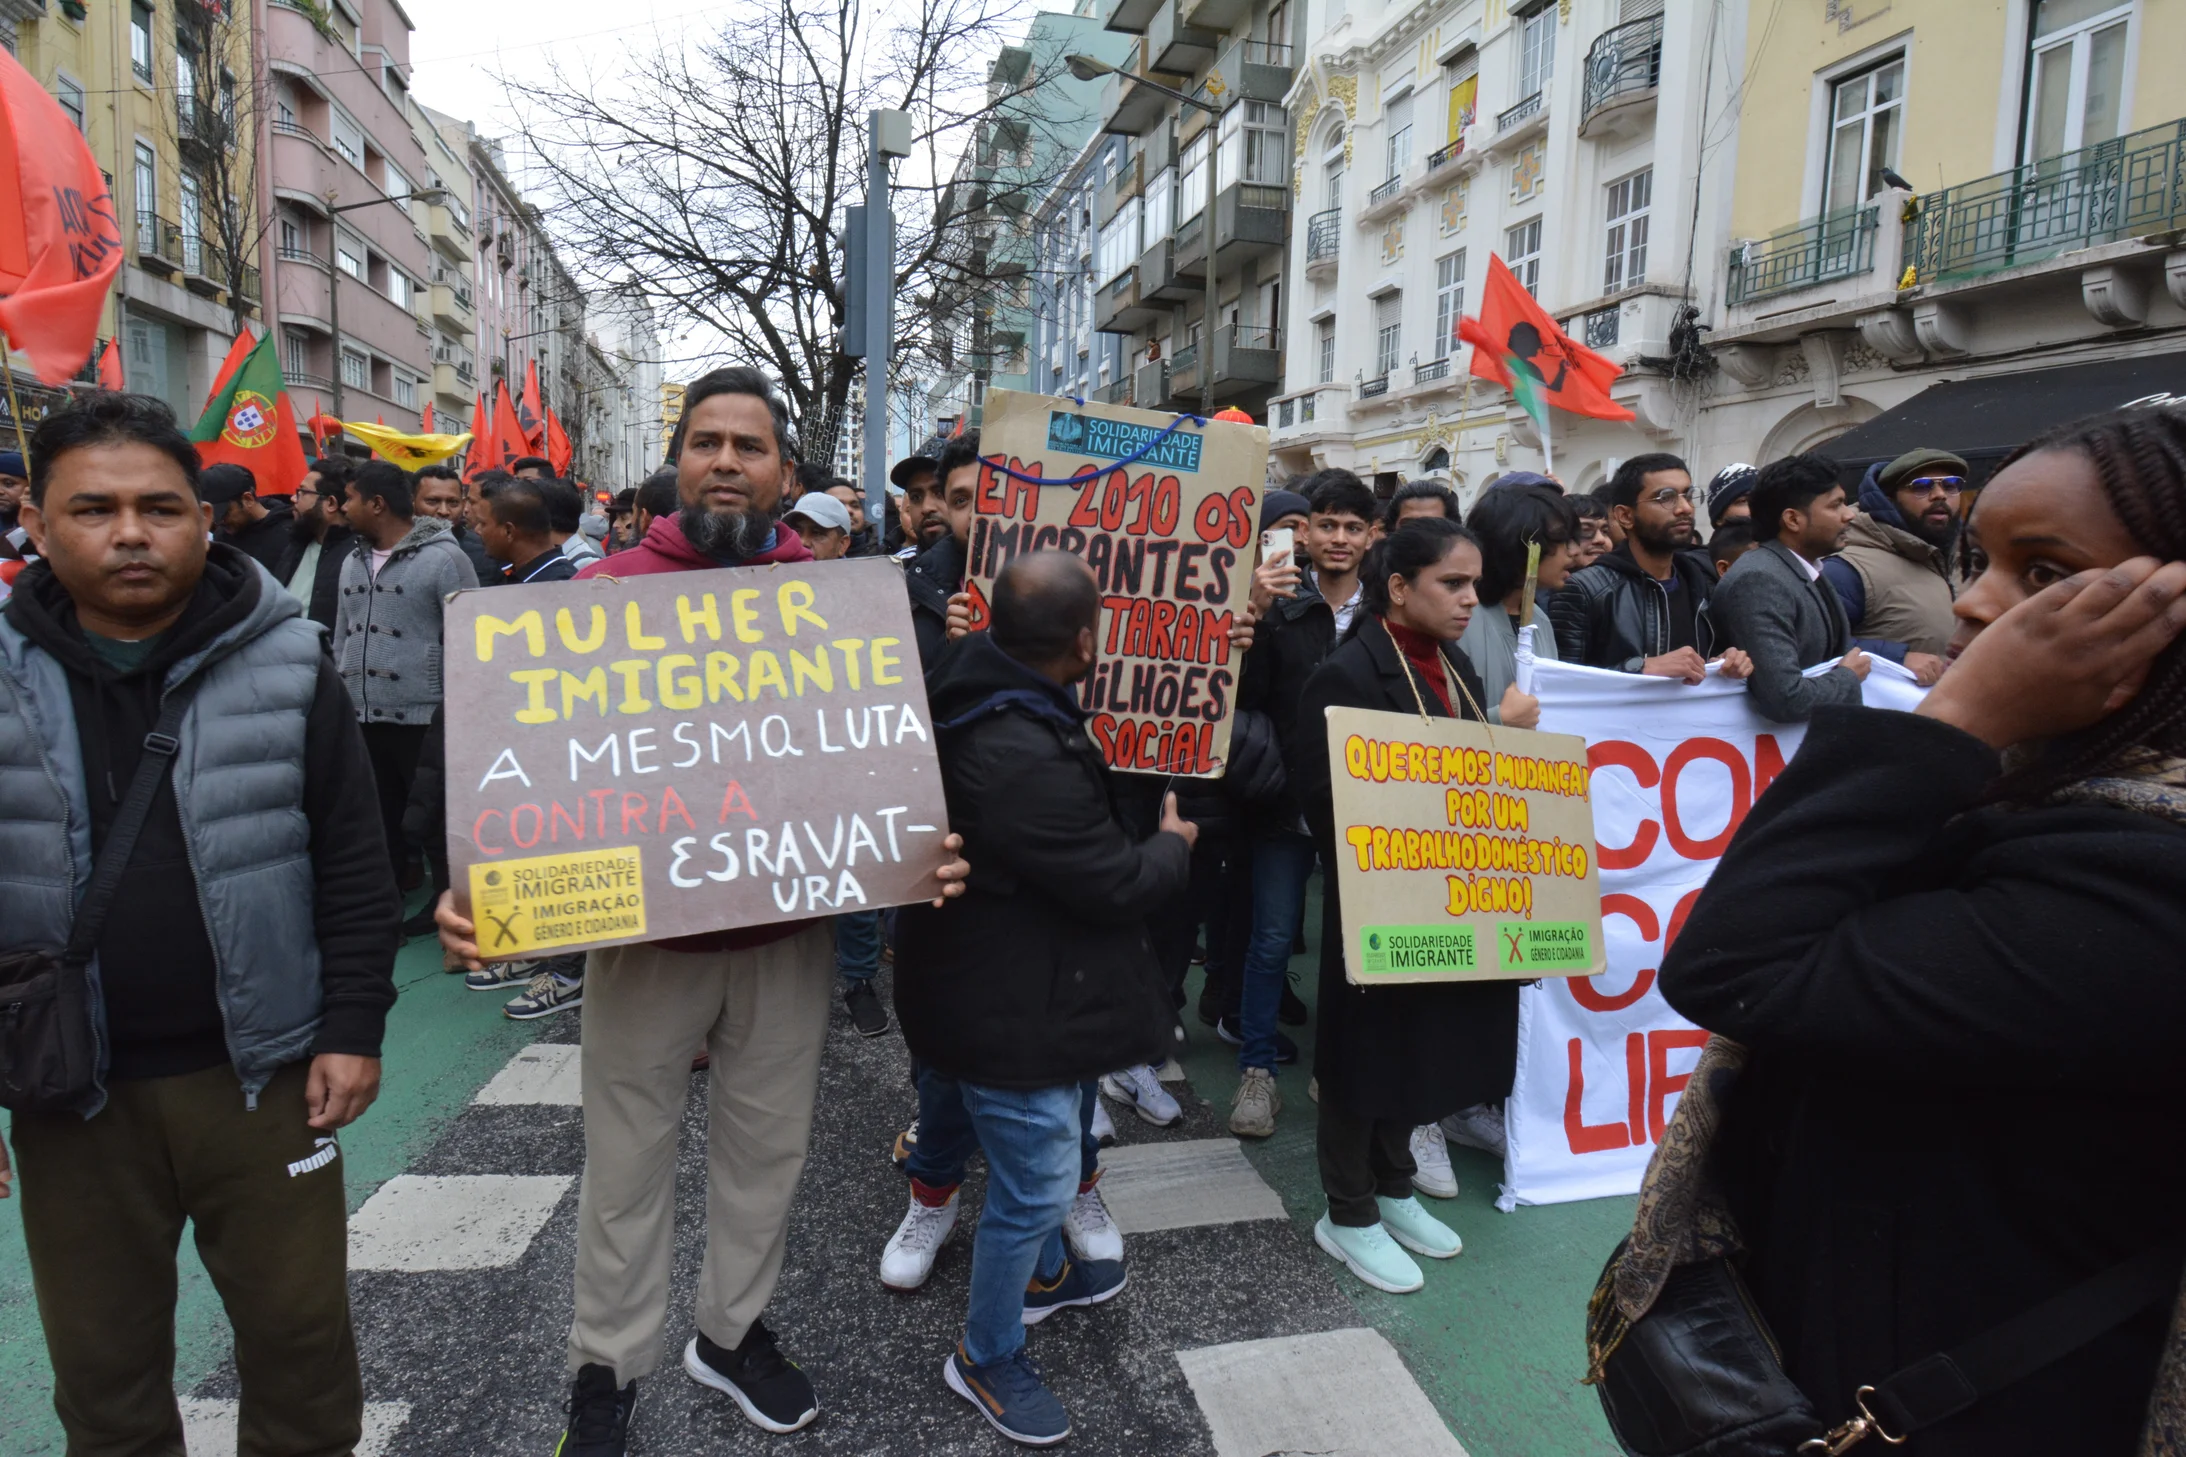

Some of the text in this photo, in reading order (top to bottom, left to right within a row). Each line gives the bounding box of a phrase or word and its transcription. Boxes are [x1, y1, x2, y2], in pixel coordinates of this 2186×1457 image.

[1089, 419, 1200, 450] SOLIDARIEDADE
[975, 453, 1255, 549] EM 2010 OS
[475, 580, 829, 662] MULHER
[509, 636, 903, 724] IMIGRANTE
[478, 748, 531, 792] A
[818, 703, 928, 754] LUTA
[1345, 734, 1588, 803] QUEREMOS MUDANÇA!
[472, 780, 759, 856] CONTRA A
[1445, 788, 1528, 832] POR UM
[513, 857, 637, 882] SOLIDARIEDADE
[515, 870, 637, 900] IMIGRANTE
[533, 893, 640, 920] IMIGRAÇÃO
[772, 869, 867, 913] URA
[585, 914, 639, 935] CIDADANIA
[1529, 926, 1584, 944] IMIGRAÇÃO
[1389, 935, 1473, 950] SOLIDARIEDADE
[1390, 949, 1474, 968] IMIGRANTE
[1557, 947, 1585, 961] CIDADANIA
[288, 1144, 337, 1177] PUMA
